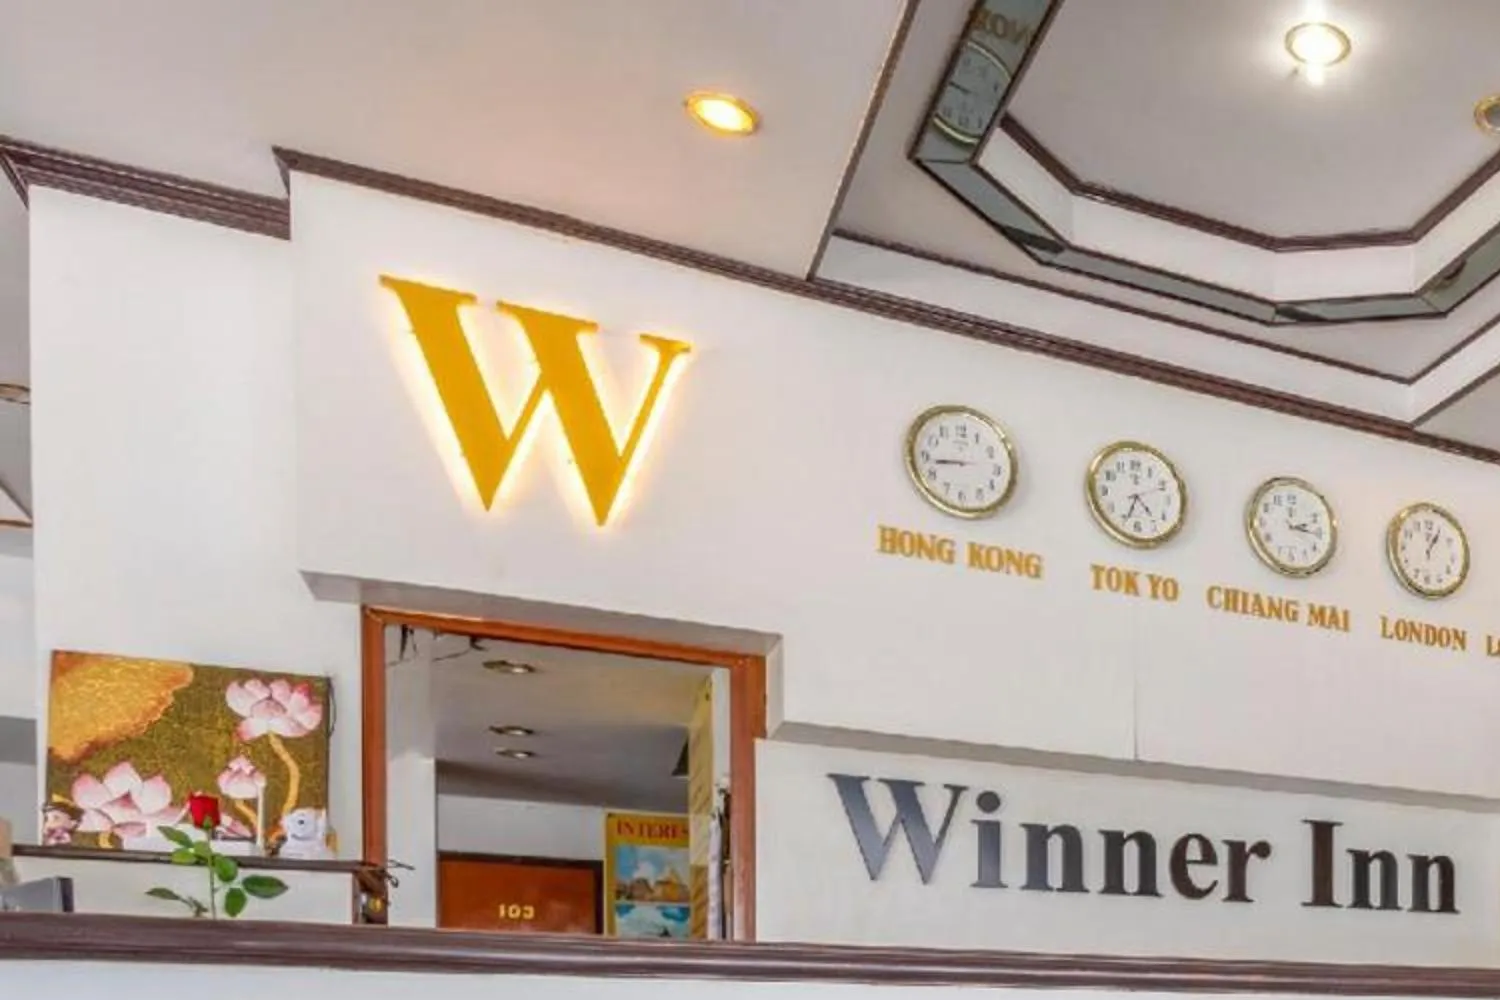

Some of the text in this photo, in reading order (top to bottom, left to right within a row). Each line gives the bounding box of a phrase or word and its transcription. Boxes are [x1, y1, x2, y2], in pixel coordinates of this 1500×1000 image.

[379, 274, 691, 527] W
[878, 524, 1043, 579] HONG KONG
[1206, 585, 1350, 632] CHIANG MAI
[1379, 615, 1467, 651] LONDON
[827, 773, 1461, 915] Winner Inn
